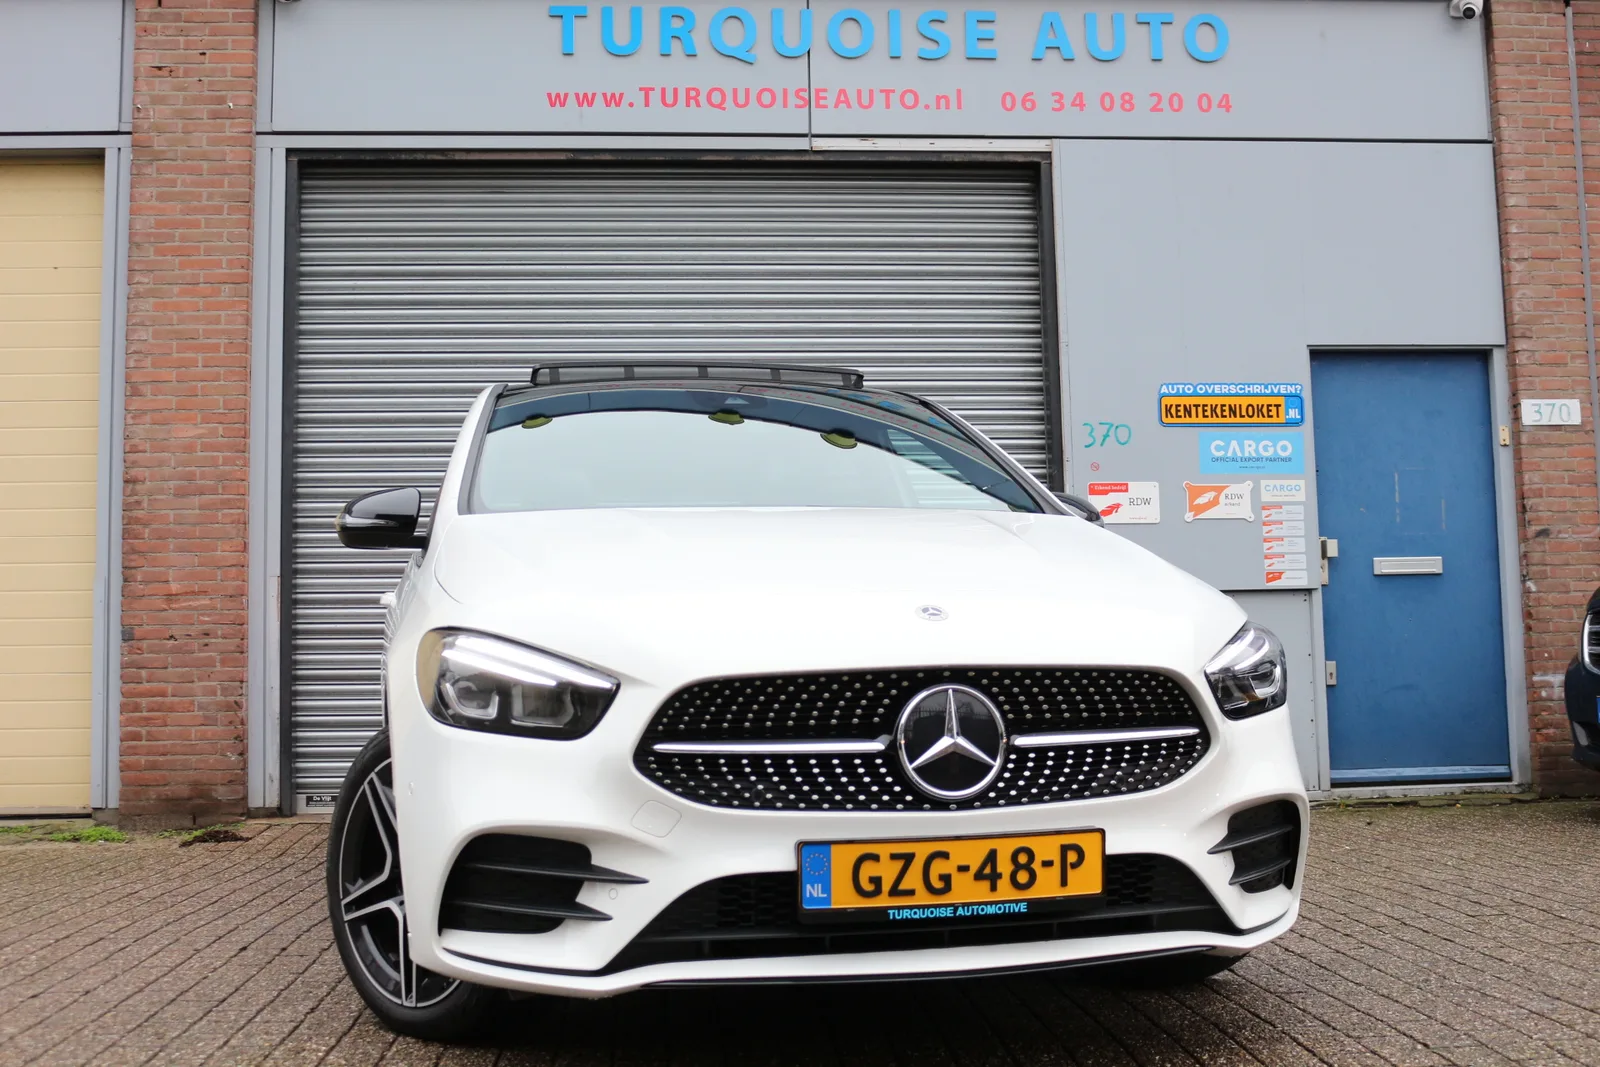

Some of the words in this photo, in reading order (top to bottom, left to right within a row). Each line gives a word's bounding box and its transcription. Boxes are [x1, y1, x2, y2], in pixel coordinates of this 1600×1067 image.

[548, 6, 997, 64] TURQUOISE
[1031, 11, 1230, 63] AUTO
[546, 87, 963, 111] www.TURQUOISEAUTO.nl
[1001, 91, 1037, 112] 06
[1051, 91, 1086, 112] 34
[1100, 92, 1135, 112] 08
[1149, 92, 1184, 113] 20
[1198, 93, 1232, 113] 04
[1160, 384, 1194, 394] AUTO
[1196, 384, 1302, 394] OVERSCHRIJVEN?
[1164, 403, 1282, 419] KENTEKENLOKET
[1531, 402, 1571, 423] 370
[1082, 421, 1132, 448] 370
[1209, 439, 1293, 457] CARGO
[1264, 484, 1301, 492] CARGO
[1129, 497, 1152, 506] RDW
[805, 883, 827, 898] NL
[851, 842, 1086, 898] GZG-48-P
[888, 906, 954, 920] TURQUOISE
[956, 902, 1028, 916] AUTOMOTIVE
